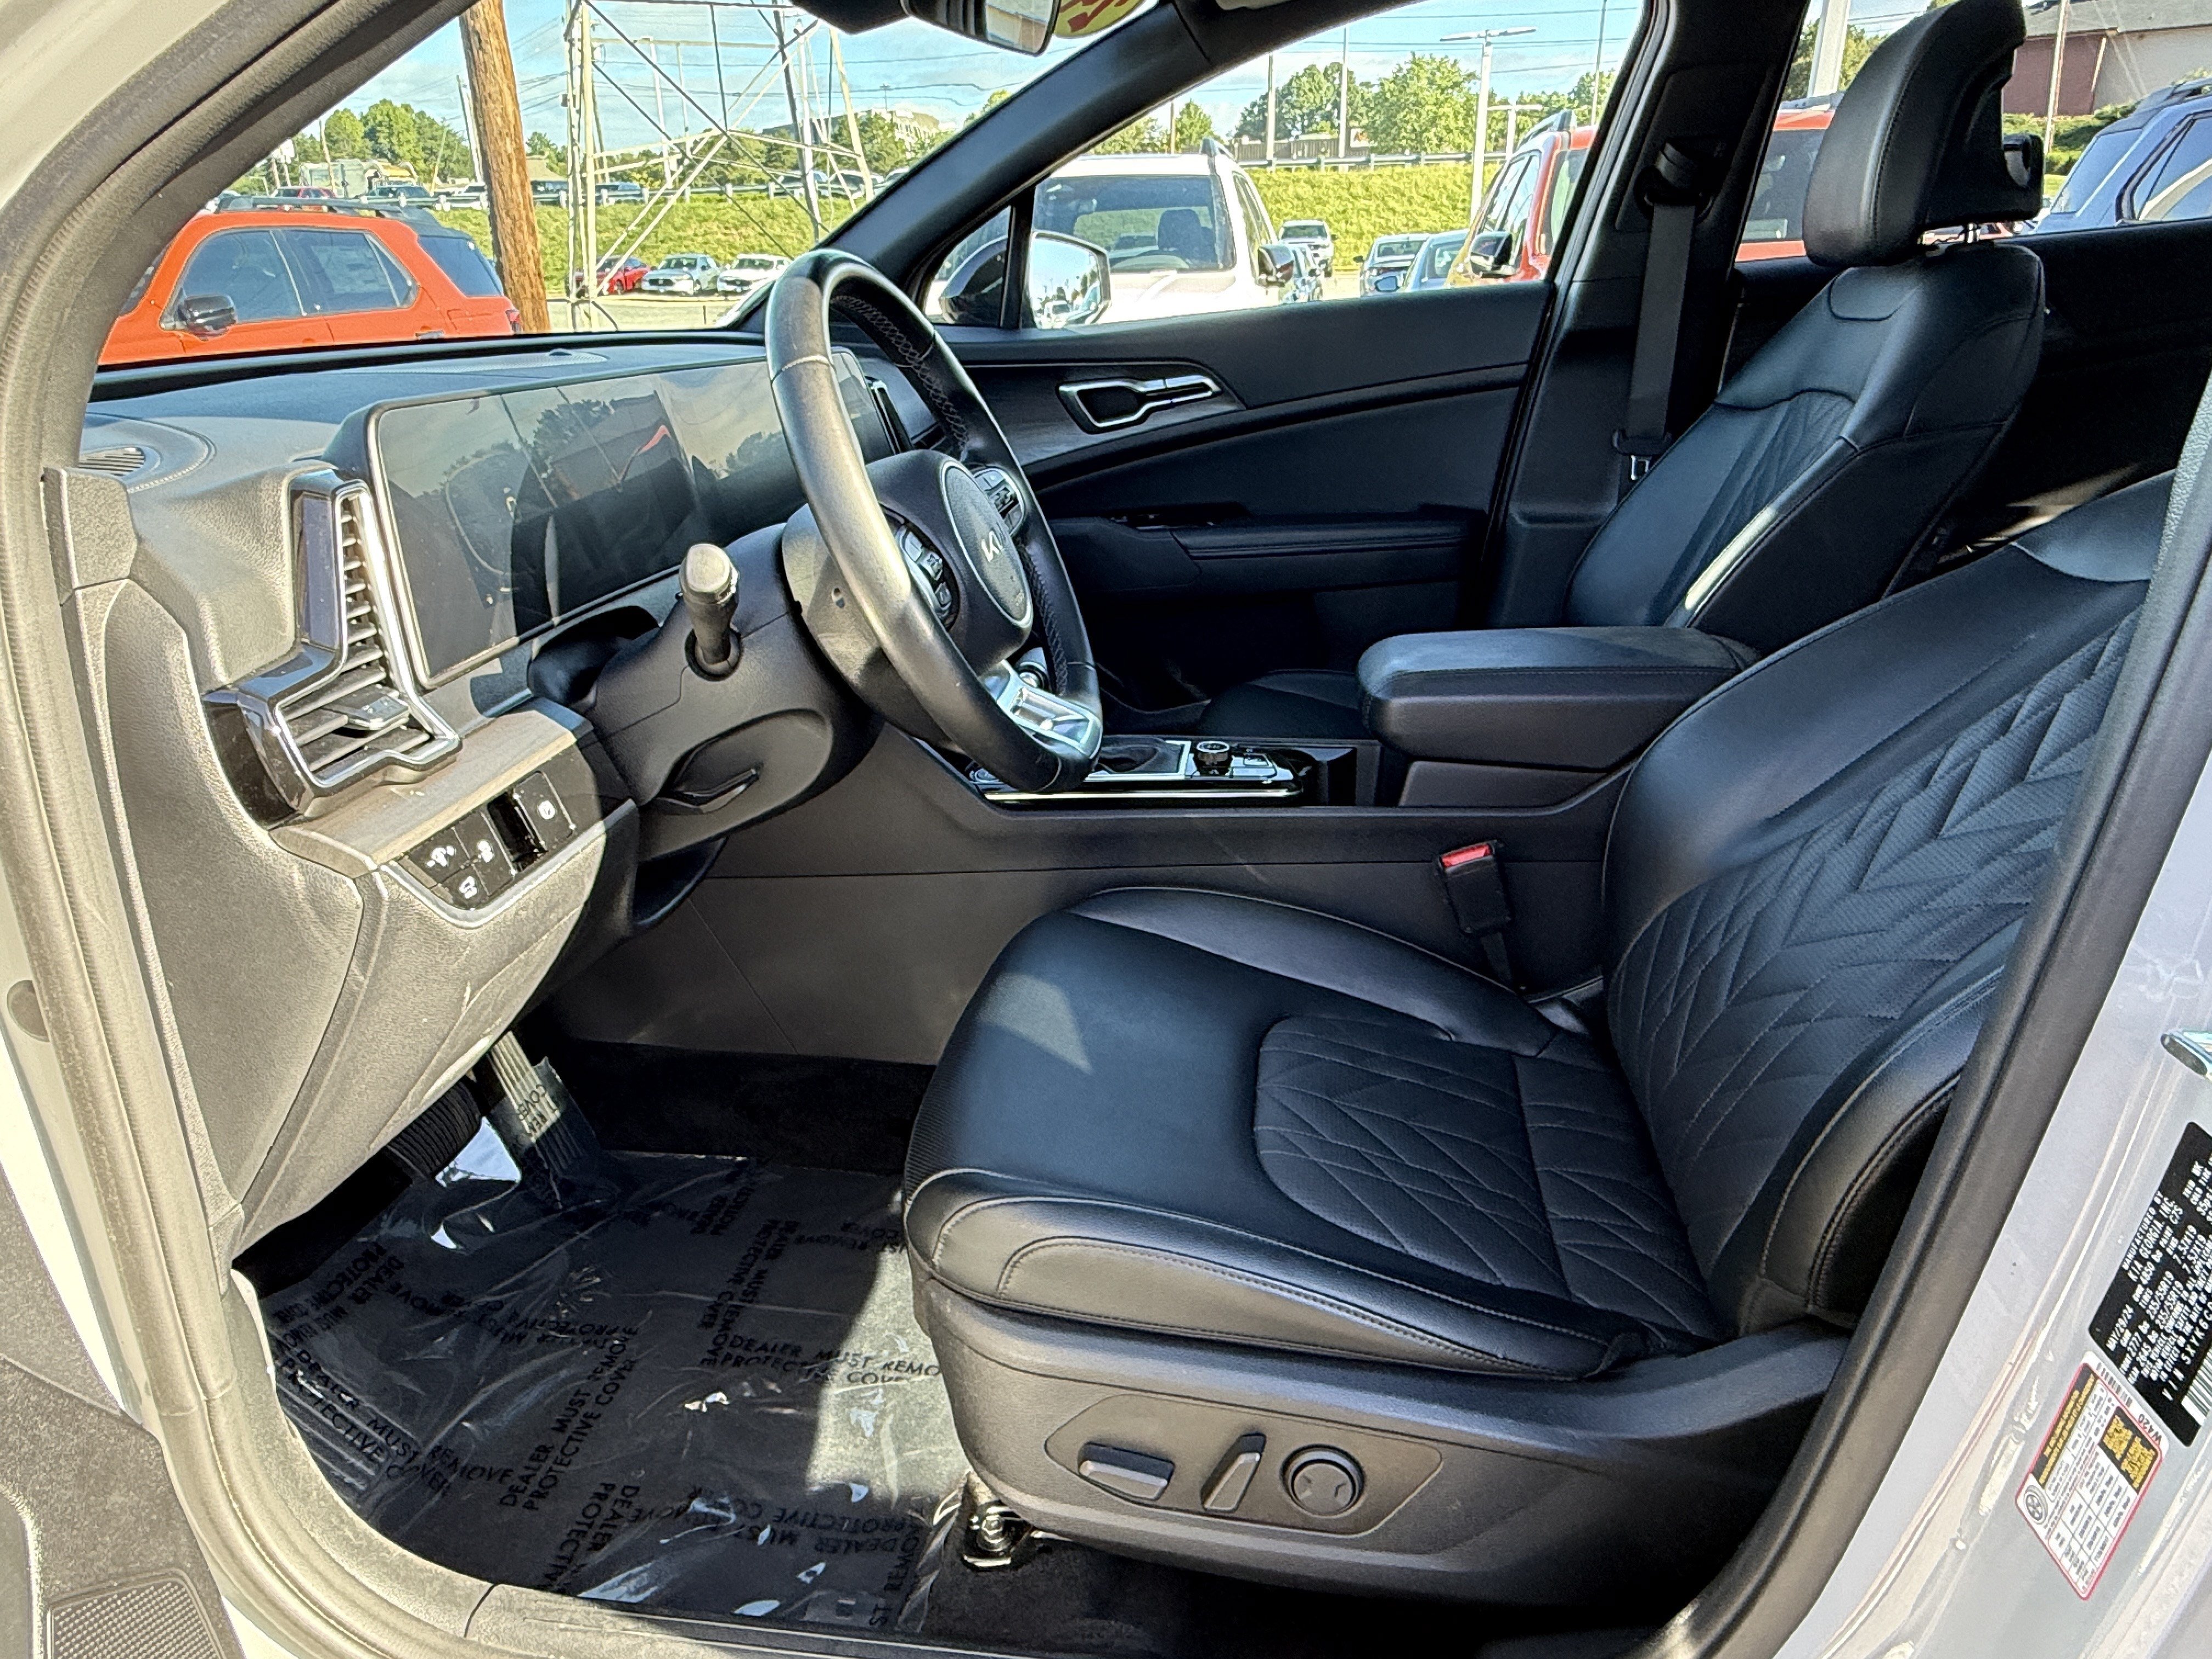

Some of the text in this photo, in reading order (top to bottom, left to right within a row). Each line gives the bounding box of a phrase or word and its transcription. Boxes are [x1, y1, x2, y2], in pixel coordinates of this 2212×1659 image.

[2121, 1189, 2163, 1270] MANUFACTURED BY
[2128, 1260, 2145, 1282] KIA
[2159, 1198, 2175, 1218] INC.
[2146, 1271, 2174, 1319] 235/55R19
[2155, 1281, 2183, 1329] 235/55R19
[729, 1334, 803, 1358] DEALER
[2106, 1304, 2134, 1351] MAY/29/24
[366, 1417, 419, 1465] MUST
[500, 1444, 555, 1506] DEALER
[551, 1389, 591, 1434] MUST
[522, 1411, 602, 1510] PROTECTIVE
[595, 1358, 637, 1406] COVER
[2138, 1413, 2162, 1445] W420
[587, 1484, 641, 1551] DEALER
[814, 1536, 898, 1554] DEALER
